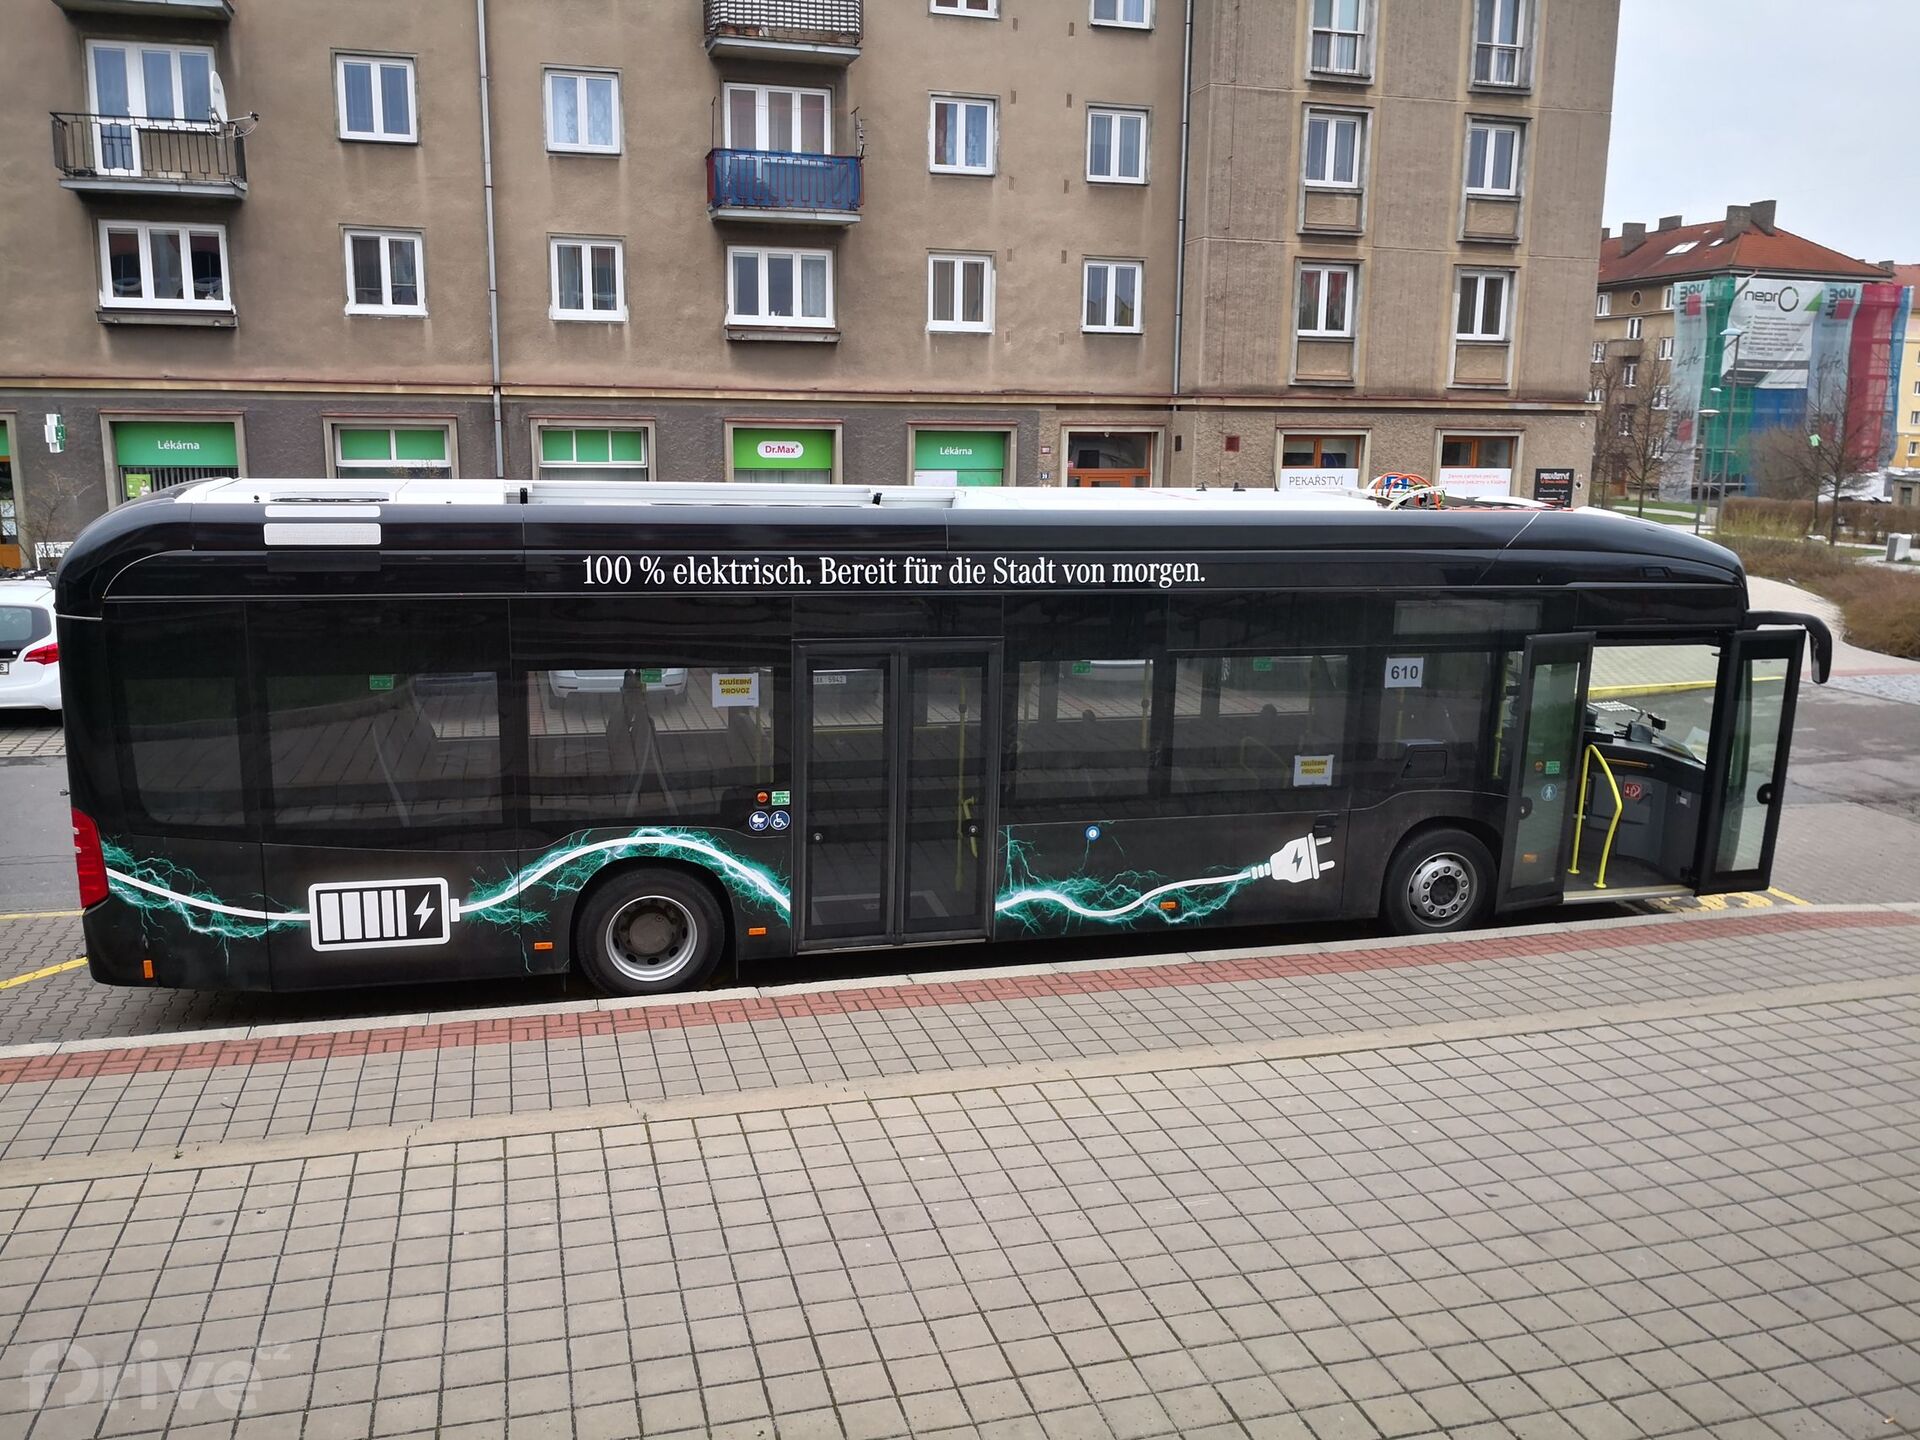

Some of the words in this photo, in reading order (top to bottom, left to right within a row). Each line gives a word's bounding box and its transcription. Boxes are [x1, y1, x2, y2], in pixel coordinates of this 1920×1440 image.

[157, 440, 200, 450] Lékárna
[765, 445, 796, 454] Dr.Max
[939, 446, 973, 456] Lékárna
[1288, 474, 1344, 486] PEKAŘSTVÍ
[582, 555, 632, 585] 100
[640, 555, 666, 585] %
[673, 556, 812, 585] elektrisch.
[819, 556, 898, 585] Bereit
[903, 556, 943, 584] für
[949, 557, 987, 585] die
[993, 556, 1056, 584] Stadt
[1062, 563, 1106, 583] von
[1112, 562, 1206, 588] morgen.
[1391, 665, 1419, 680] 610
[721, 687, 750, 695] PROVOZ
